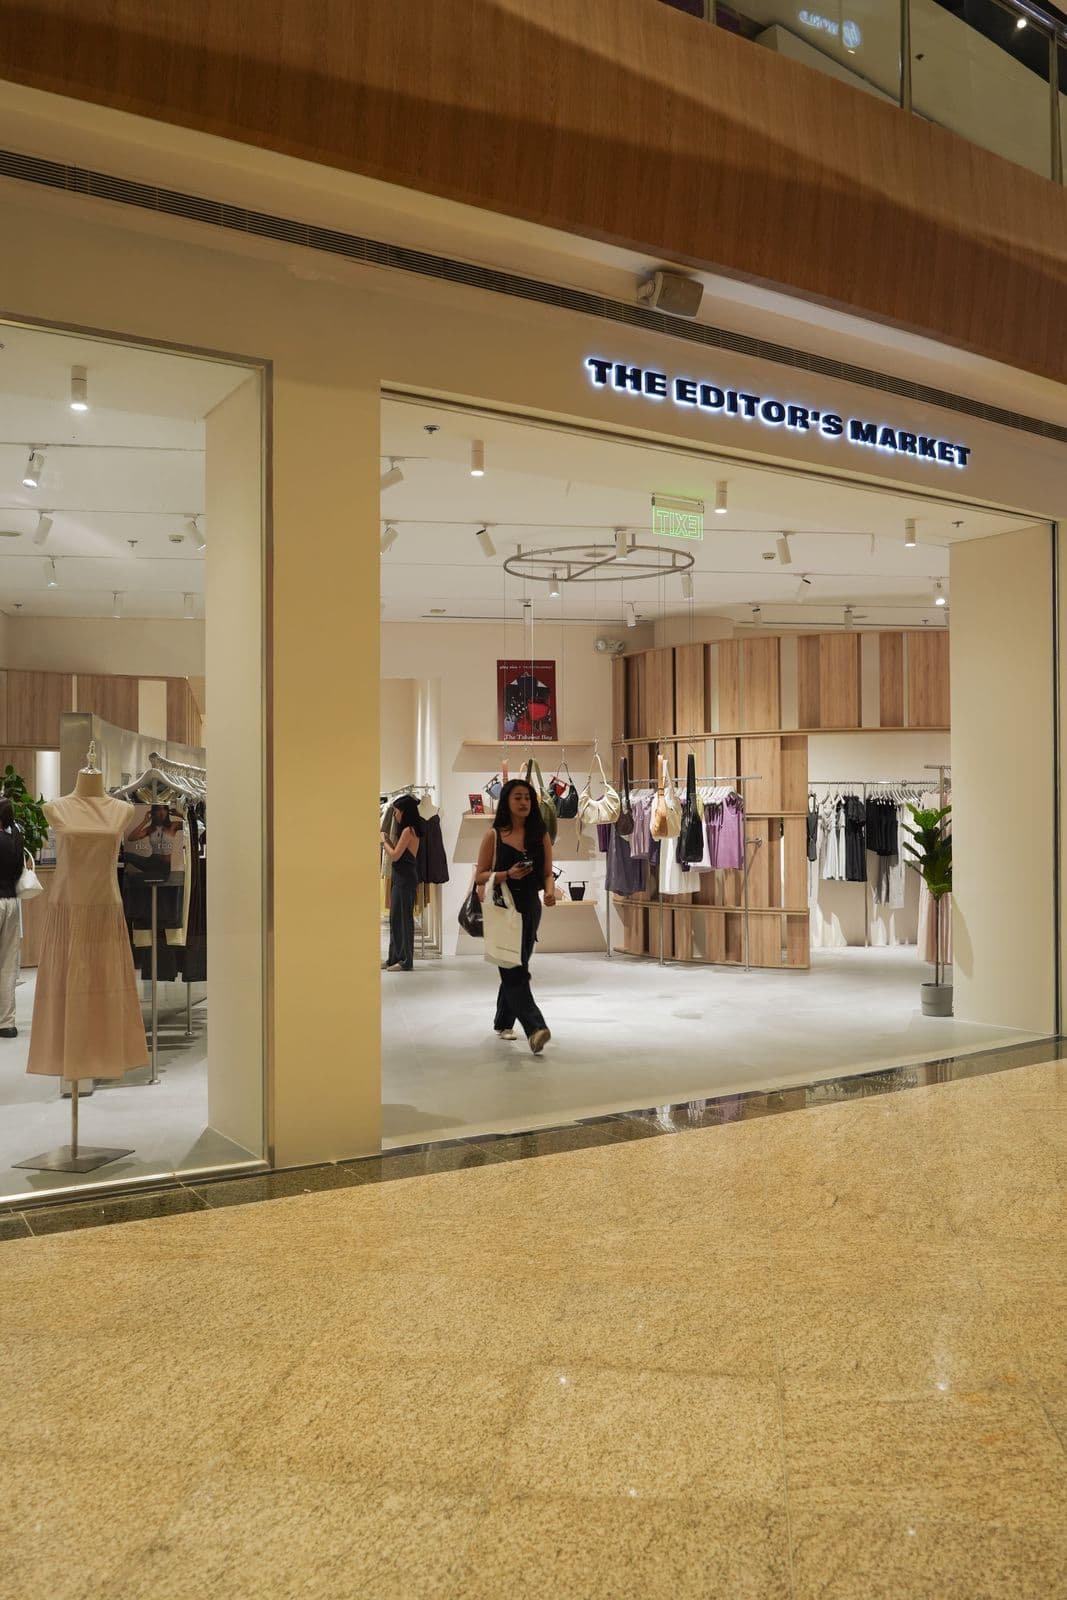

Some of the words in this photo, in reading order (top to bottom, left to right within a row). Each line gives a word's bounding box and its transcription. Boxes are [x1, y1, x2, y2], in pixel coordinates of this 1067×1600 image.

[588, 358, 667, 397] THE
[675, 378, 843, 435] EDITOR'S
[850, 419, 971, 466] MARKET
